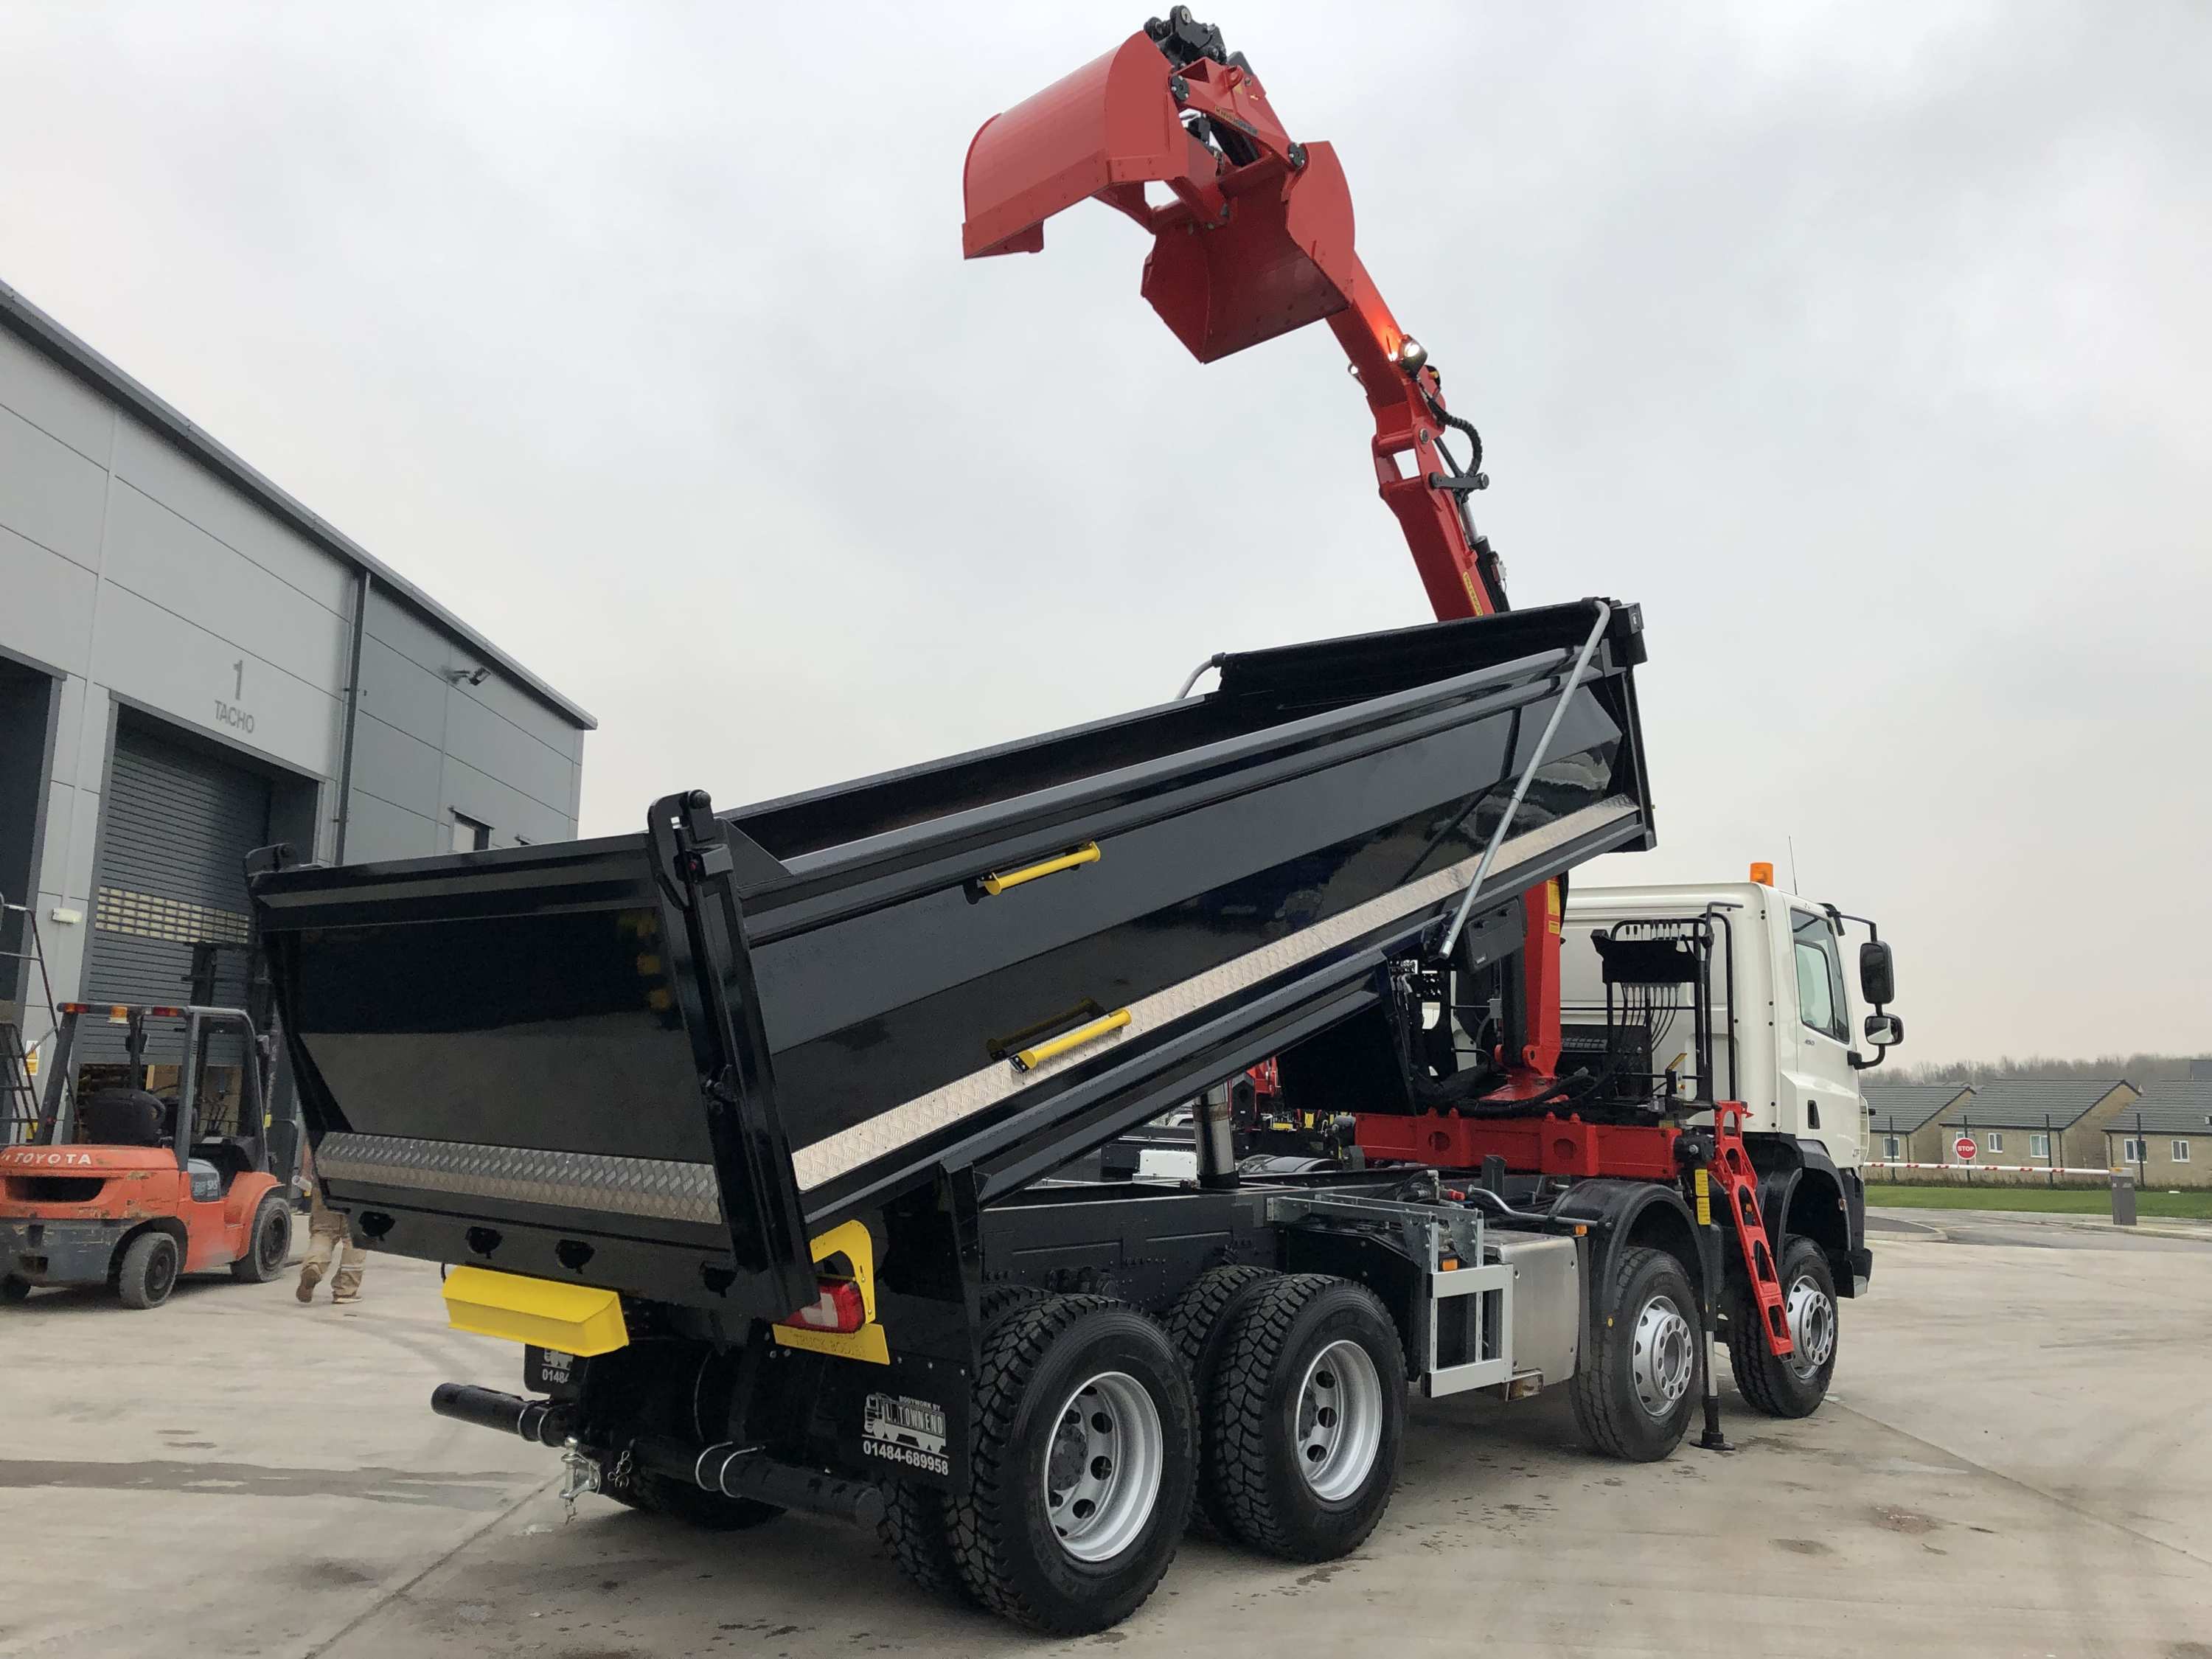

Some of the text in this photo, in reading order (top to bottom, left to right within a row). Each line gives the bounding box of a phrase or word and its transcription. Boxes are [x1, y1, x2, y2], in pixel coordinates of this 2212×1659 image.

[234, 660, 243, 700] 1
[215, 699, 254, 734] TACHO
[15, 1152, 91, 1165] TOYOTA
[898, 1405, 943, 1435] TOWNEND
[932, 1403, 941, 1412] BY
[863, 1440, 949, 1476] 01484-689958
